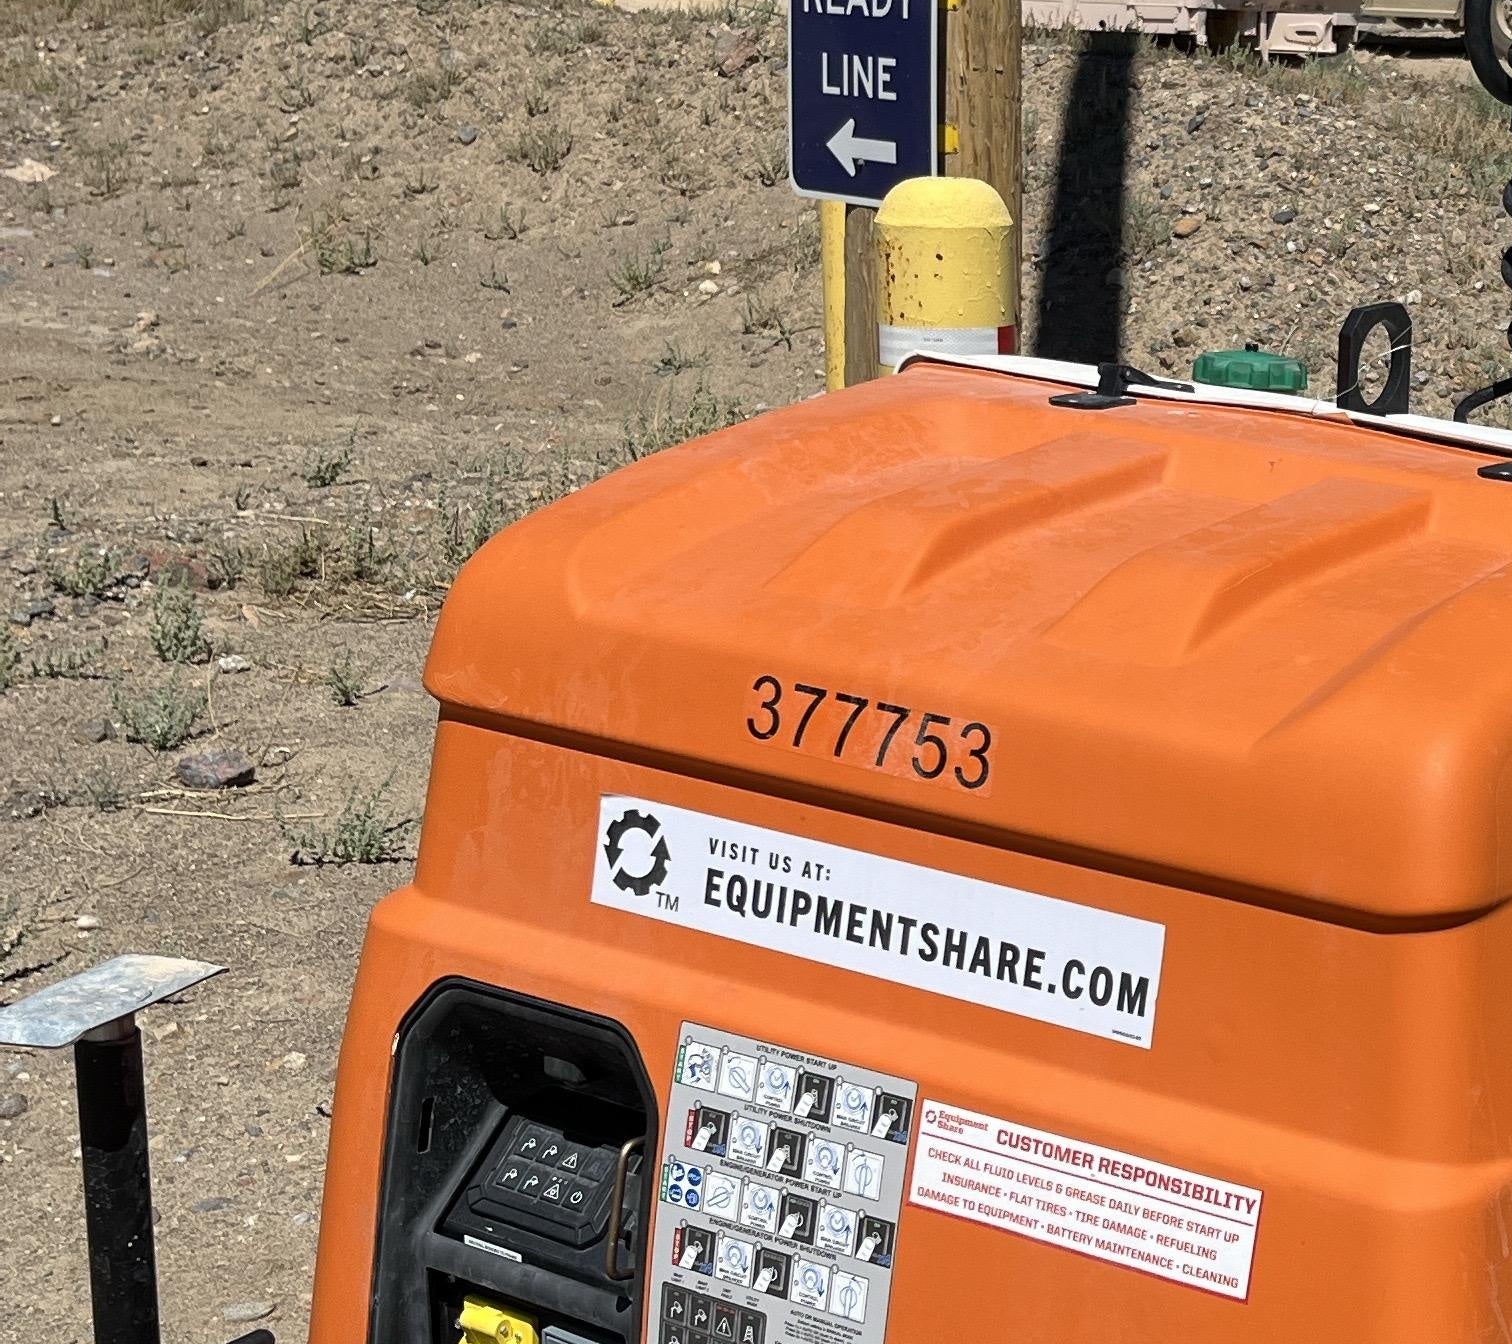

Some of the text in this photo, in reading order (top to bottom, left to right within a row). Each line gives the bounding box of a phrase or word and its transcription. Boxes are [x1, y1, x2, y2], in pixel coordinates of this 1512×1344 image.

[822, 51, 897, 101] LINE
[745, 674, 994, 792] 377753
[655, 890, 680, 913] TM
[708, 837, 832, 882] VISIT US AT:
[703, 866, 1151, 1018] EQUIPMENTSHARE.COM
[936, 1120, 964, 1135] Share
[938, 1109, 989, 1132] Equipment
[927, 1146, 1240, 1244] CHECK ALL FLUID LEVELS & GREASE DAILY BEFORE START UP
[941, 1171, 1218, 1261] INSURANCE FLAT TIRES TIRE DAMAGE REFUELING
[995, 1128, 1257, 1216] CUSTOMER RESPONSIBILITY
[916, 1186, 1240, 1289] DAMAGE TO EQUIPMENT BATTERY MAINTENANCE CLEANING
